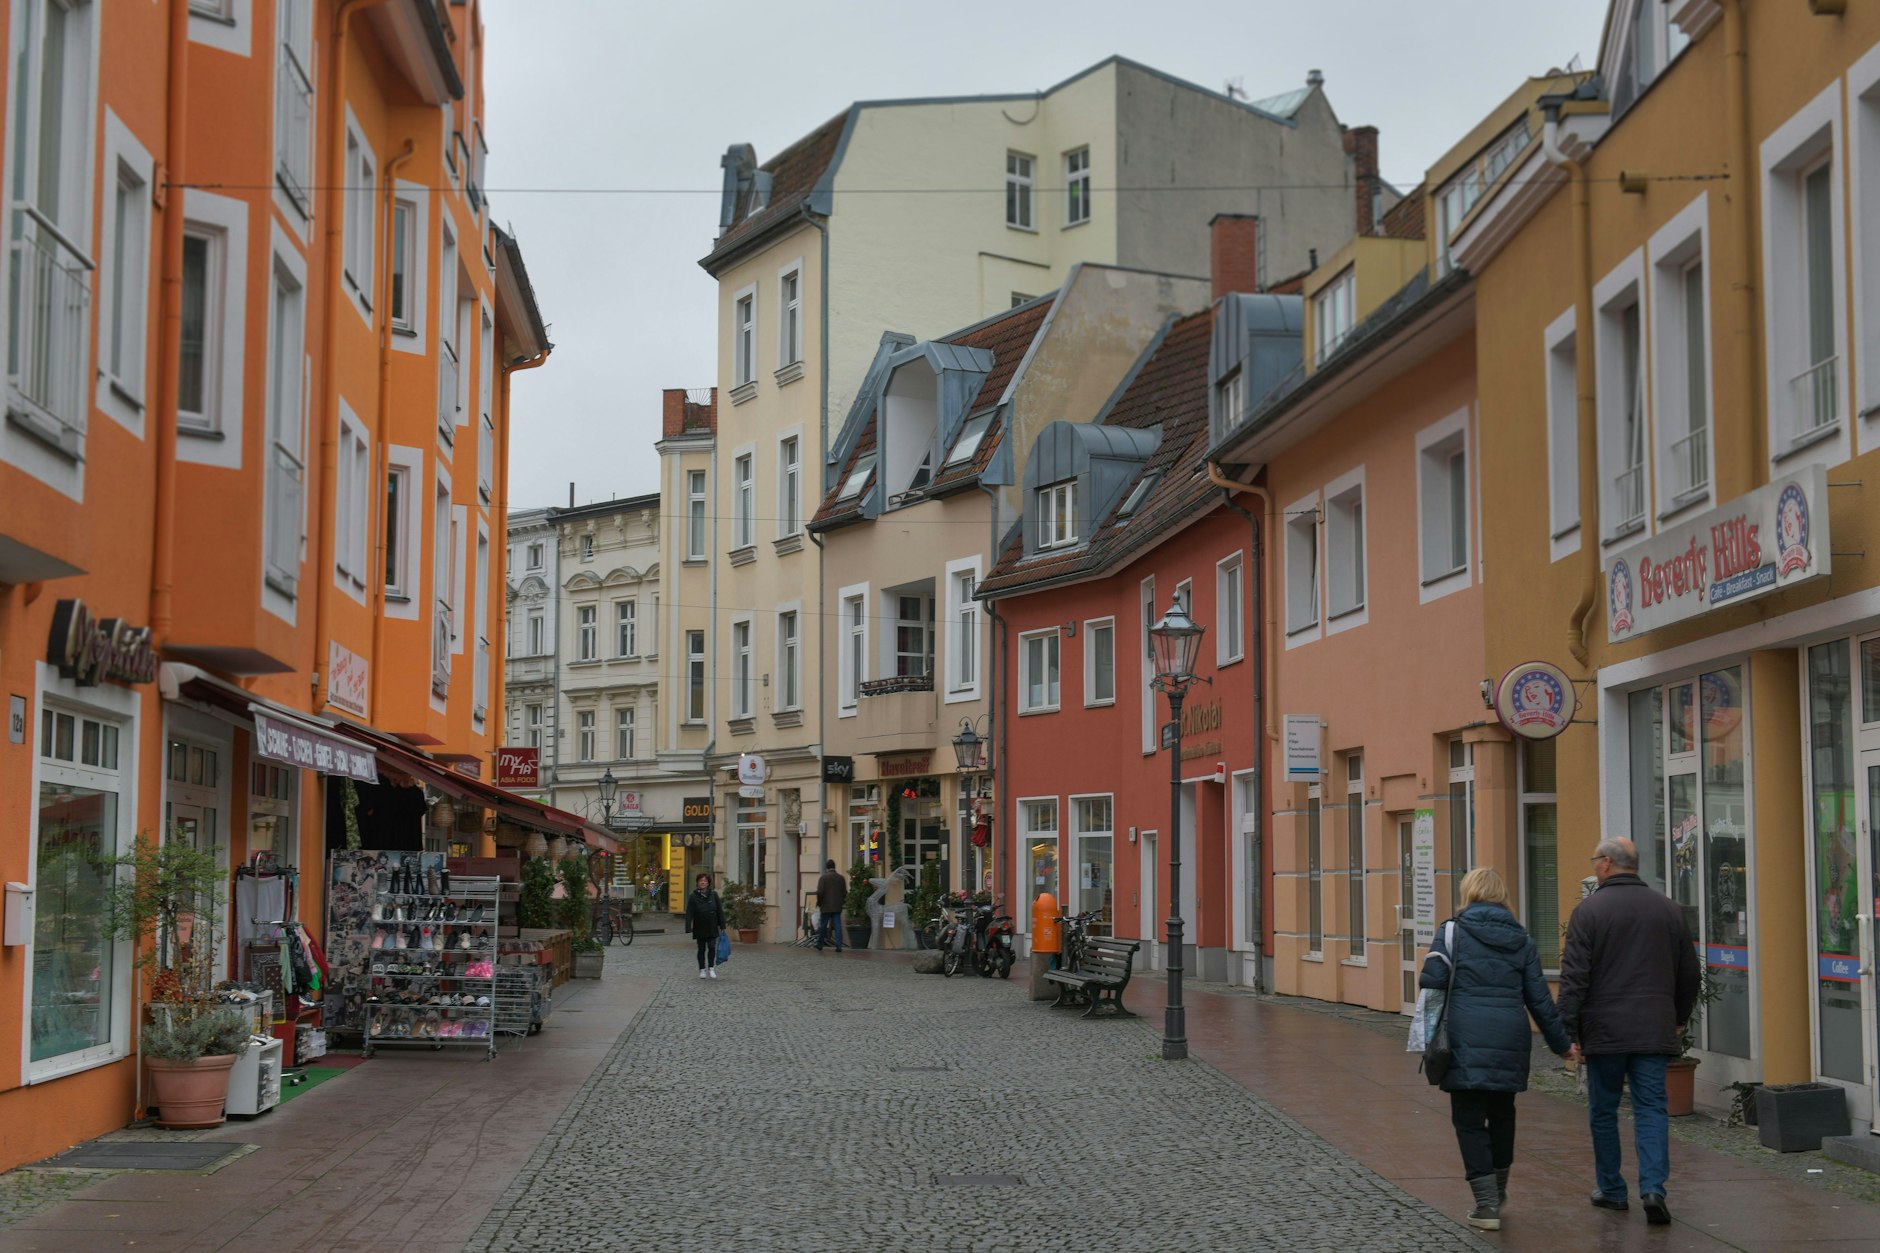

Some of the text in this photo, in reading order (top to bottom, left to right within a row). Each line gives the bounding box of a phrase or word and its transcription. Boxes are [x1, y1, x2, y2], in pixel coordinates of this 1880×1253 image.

[1639, 536, 1707, 609] Beverly
[1711, 514, 1761, 582] Hills
[1727, 575, 1753, 596] Breakfast
[1756, 567, 1774, 585] Snack
[827, 762, 849, 778] sky
[500, 776, 536, 784] ASIA FOOD
[684, 804, 710, 817] GOLD
[1832, 961, 1849, 975] Coffee
